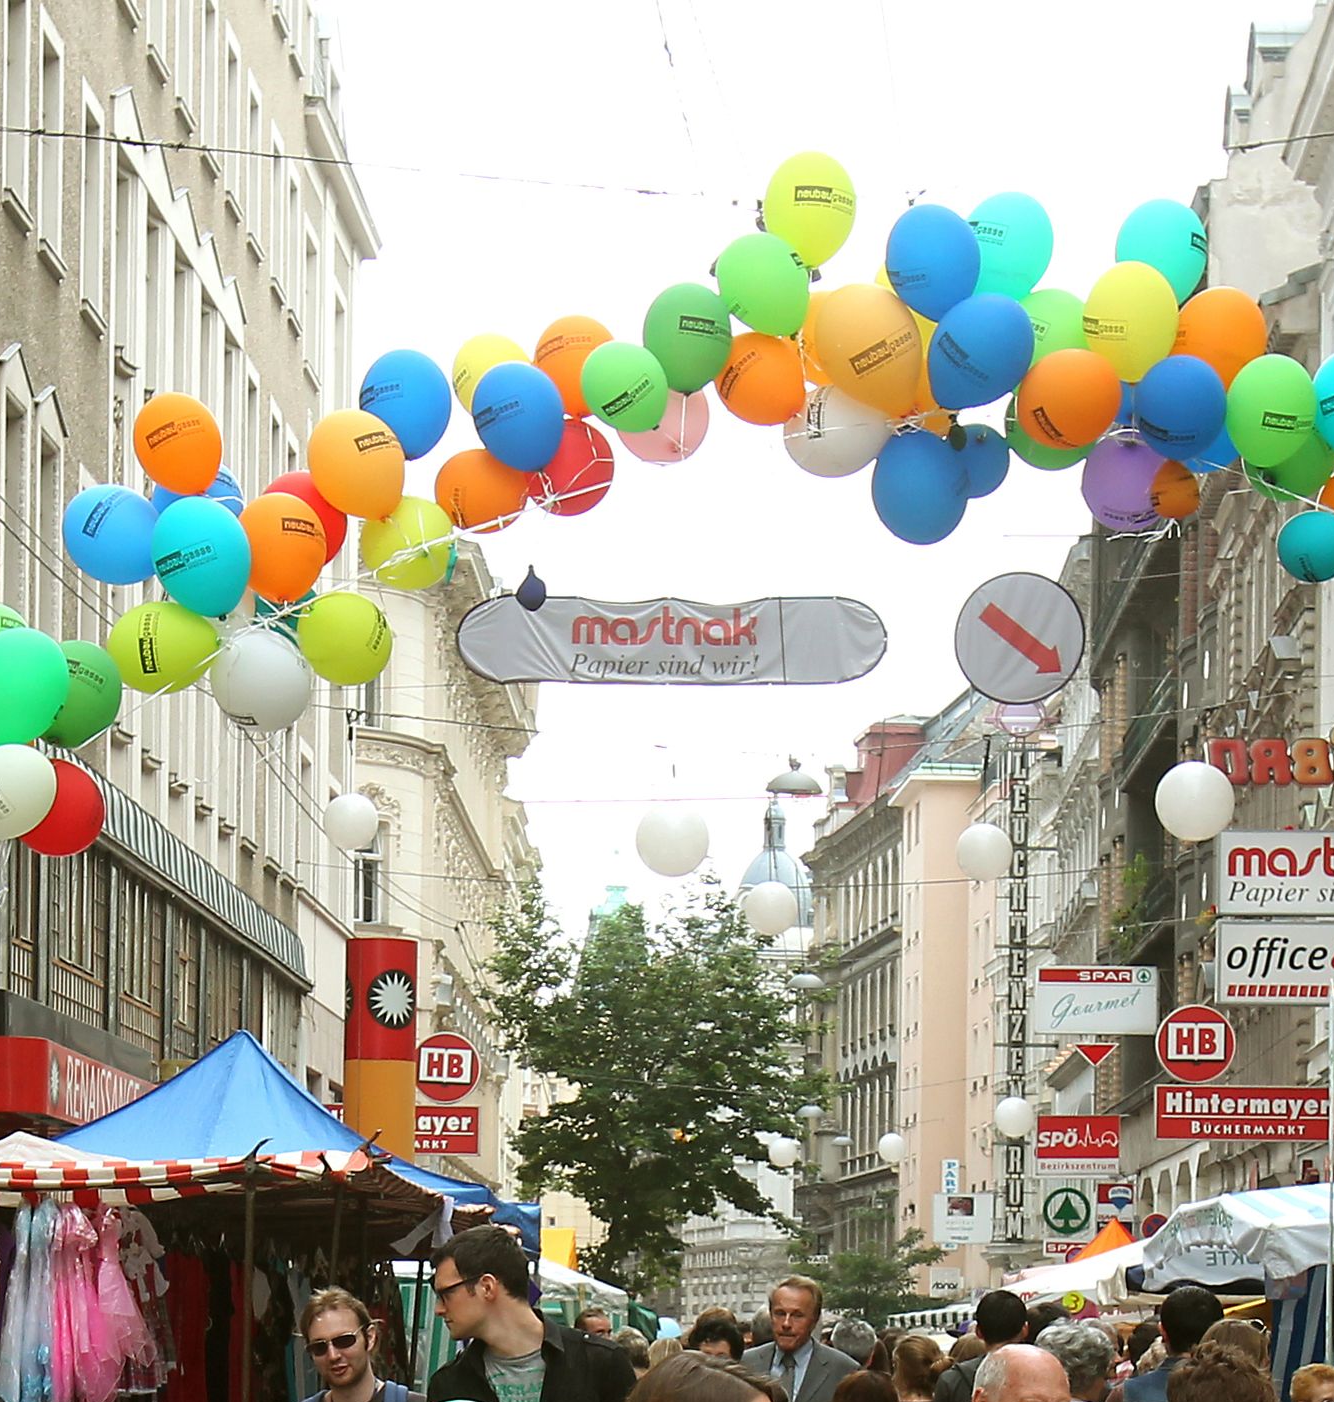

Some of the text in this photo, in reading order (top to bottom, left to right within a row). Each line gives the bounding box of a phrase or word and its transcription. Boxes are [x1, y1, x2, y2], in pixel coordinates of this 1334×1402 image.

[572, 606, 757, 646] mastnak
[571, 653, 759, 679] Papier sind wir!
[1228, 881, 1310, 907] Papier
[1078, 970, 1132, 981] SPAR
[1007, 752, 1027, 1242] LEUCHTENZERUM
[1051, 988, 1141, 1029] Gourmet
[1176, 1027, 1218, 1055] HB
[427, 1047, 465, 1077] HB
[1166, 1090, 1331, 1120] Hintermayer
[1038, 1126, 1078, 1148] SPÖ
[1191, 1119, 1306, 1136] BÜCHERMARKT
[1040, 1161, 1117, 1171] Bezirkszentrum
